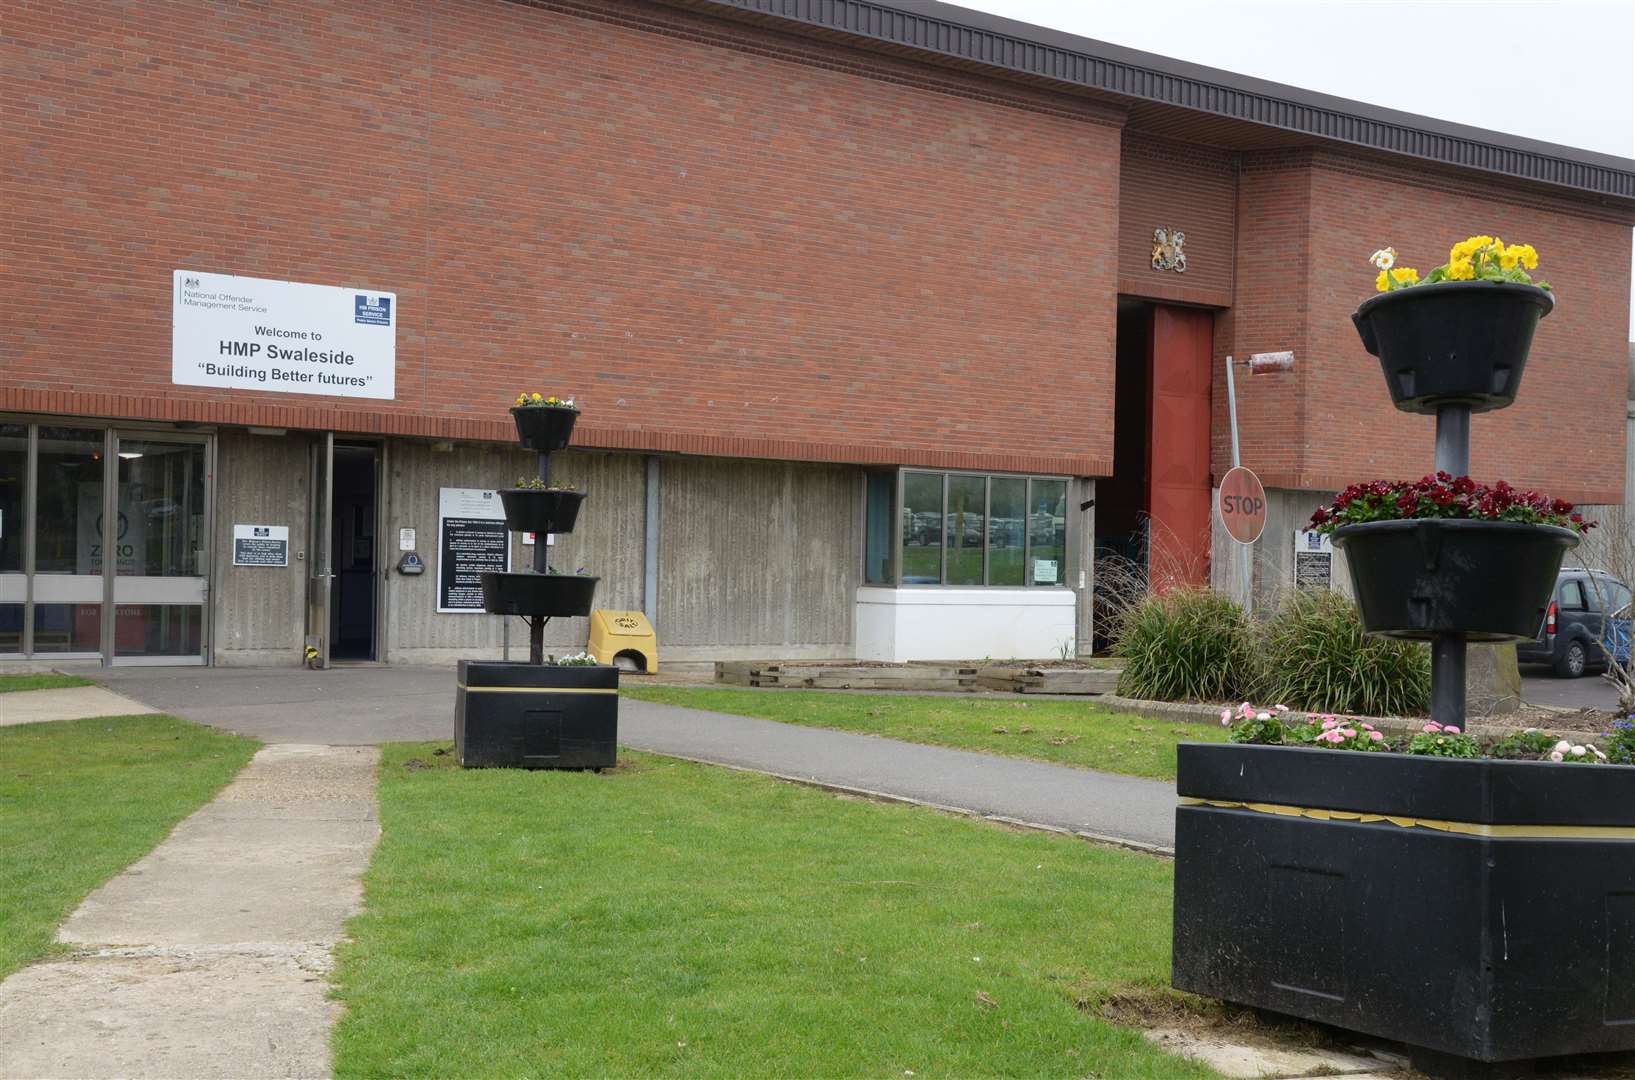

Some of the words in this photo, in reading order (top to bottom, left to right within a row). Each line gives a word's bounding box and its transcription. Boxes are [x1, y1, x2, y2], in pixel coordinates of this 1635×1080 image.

[184, 289, 217, 300] National
[219, 293, 253, 303] Offender
[184, 298, 236, 310] Management
[238, 304, 268, 313] Service
[254, 325, 308, 340] Welcome
[311, 331, 322, 341] to
[219, 340, 261, 357] HMP
[267, 344, 355, 365] Swaleside
[271, 368, 313, 383] Better
[1223, 495, 1263, 516] STOP
